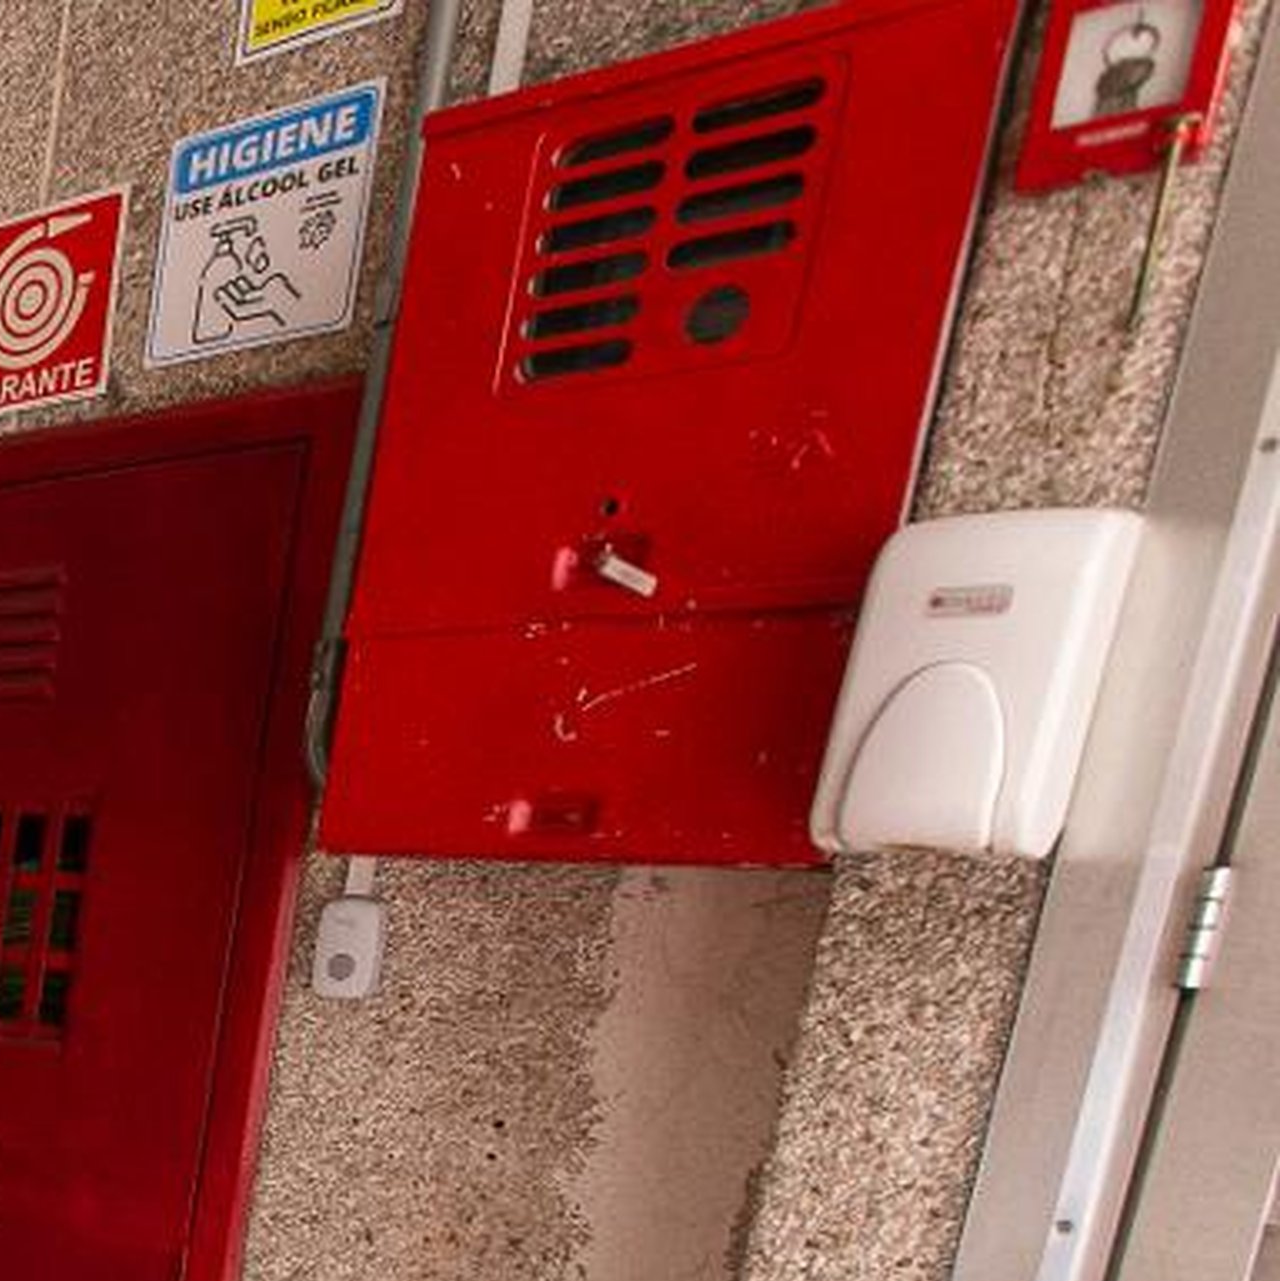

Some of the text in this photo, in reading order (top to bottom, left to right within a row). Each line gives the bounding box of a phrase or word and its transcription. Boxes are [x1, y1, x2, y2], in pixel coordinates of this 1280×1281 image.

[188, 102, 360, 184] HIGIENE
[173, 196, 213, 222] USE
[317, 155, 360, 183] GEL
